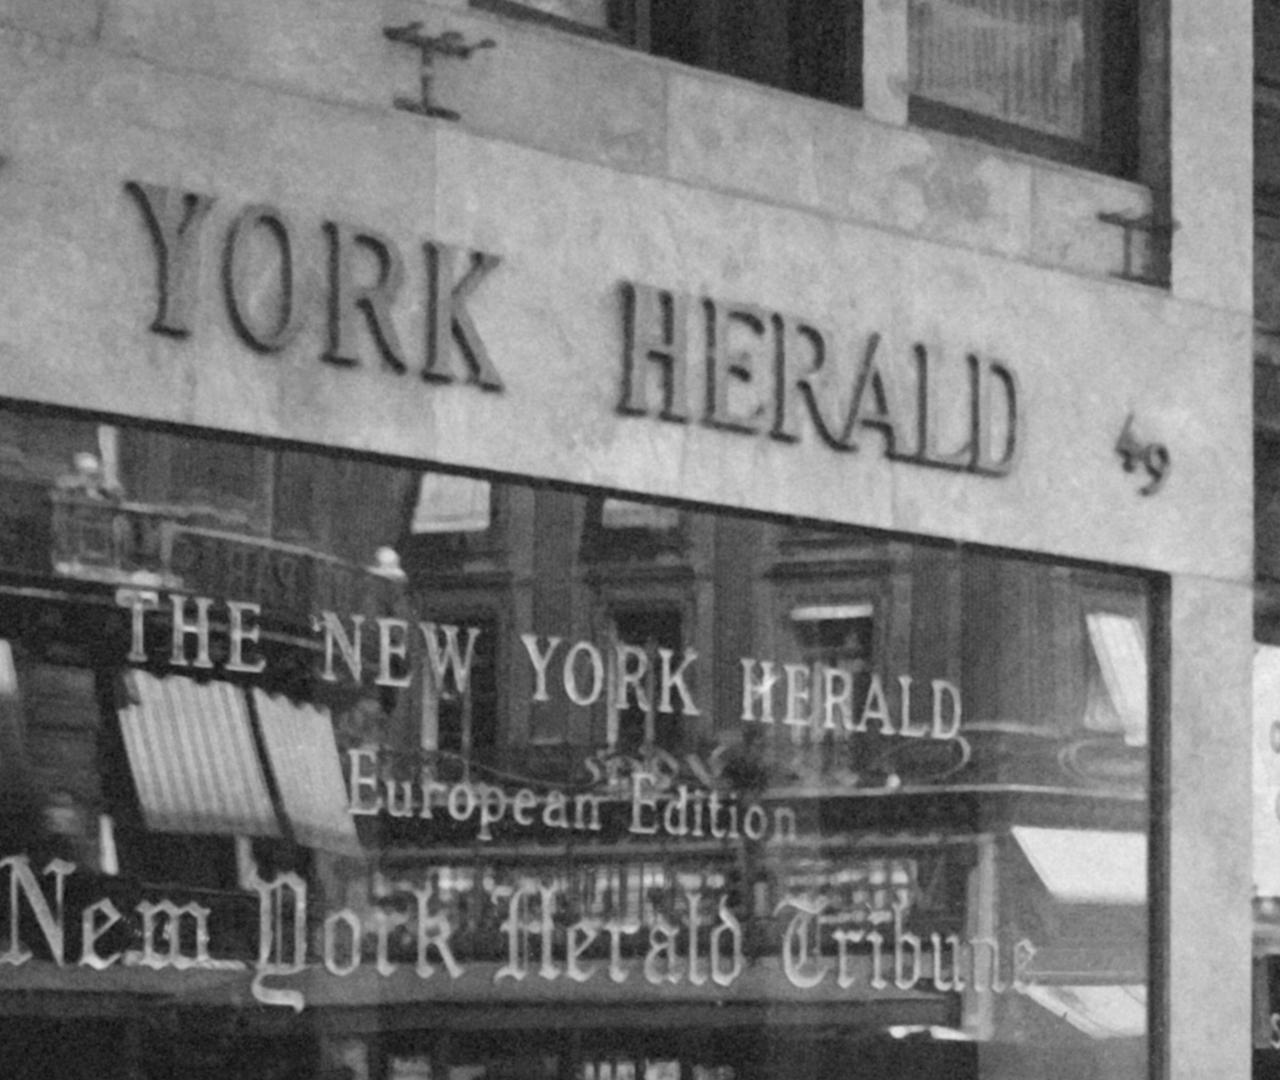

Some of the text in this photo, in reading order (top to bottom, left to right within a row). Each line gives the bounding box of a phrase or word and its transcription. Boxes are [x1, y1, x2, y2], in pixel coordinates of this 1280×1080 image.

[122, 178, 507, 394] YORK
[615, 279, 1019, 478] HERALD
[1113, 409, 1172, 497] 49
[118, 590, 964, 741] THE NEW YORK HERALD
[347, 748, 602, 841] European
[627, 771, 798, 840] Edition
[247, 871, 465, 1013] York
[491, 884, 742, 987] Herald
[772, 892, 1036, 993] Tribune
